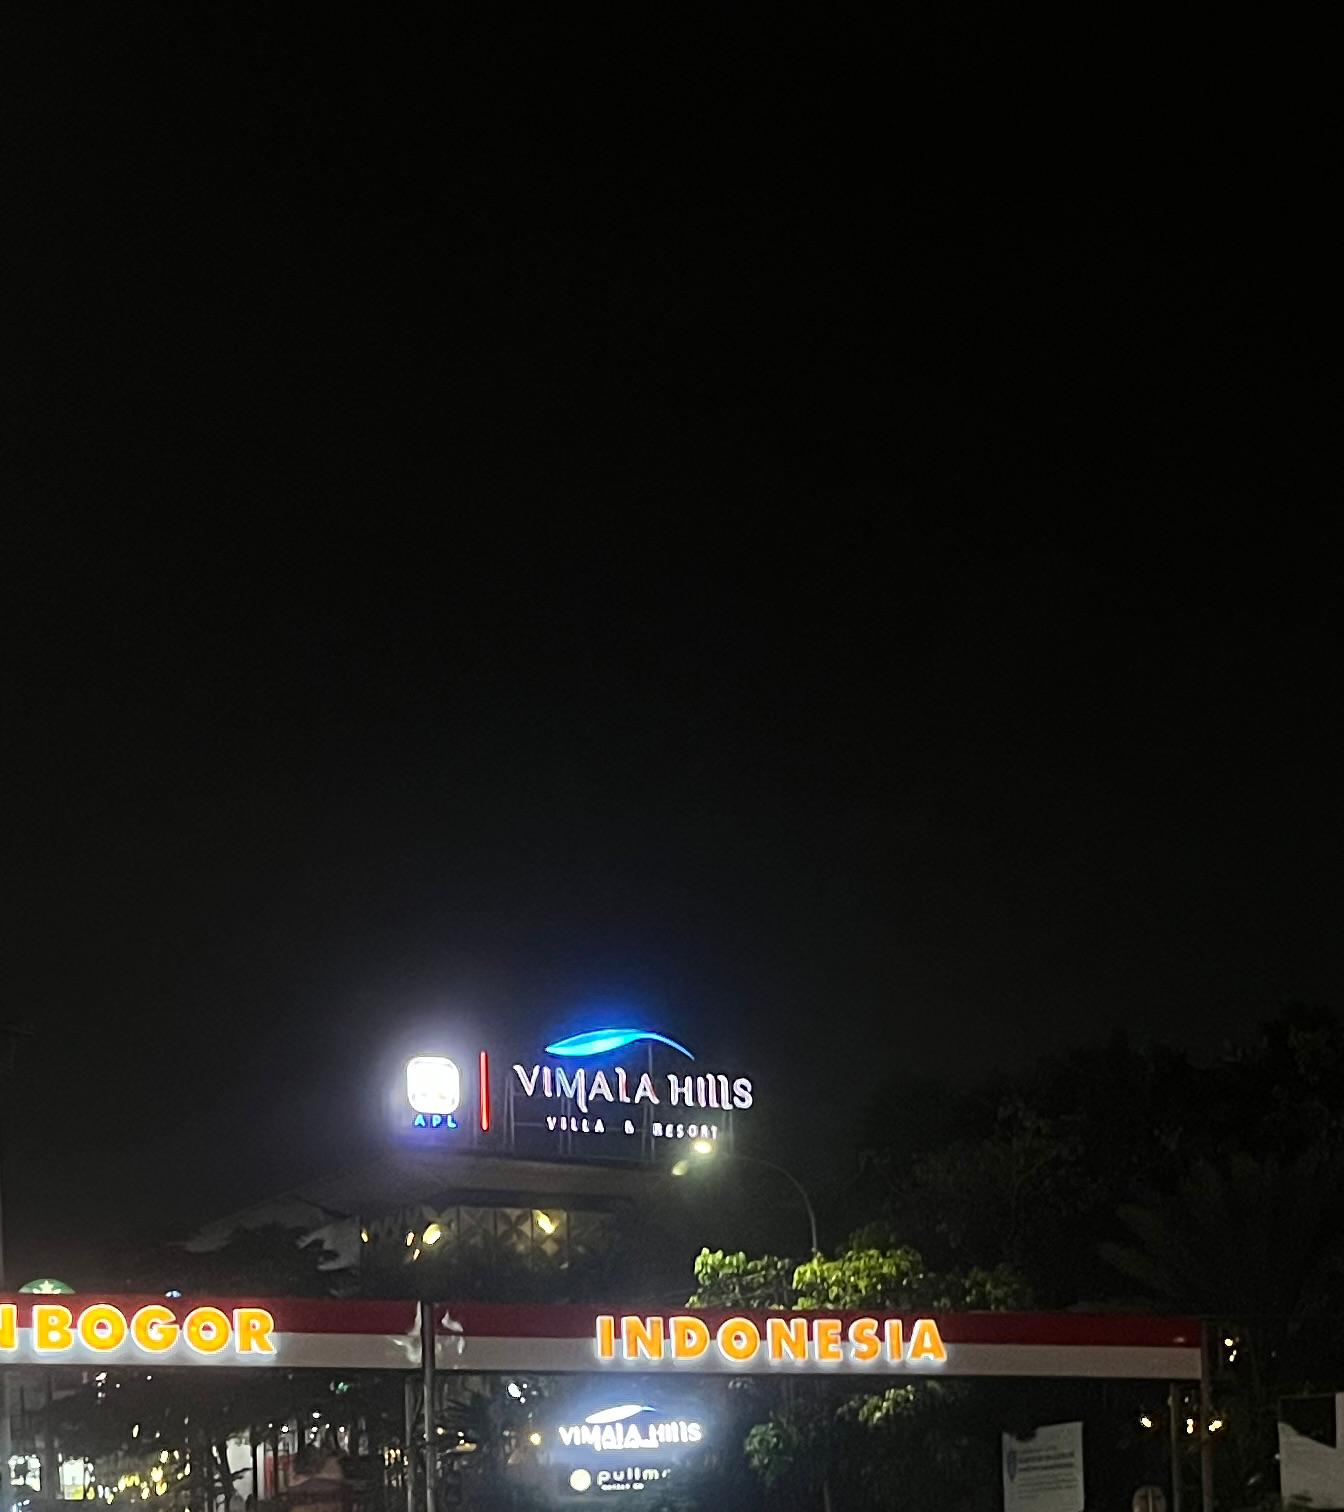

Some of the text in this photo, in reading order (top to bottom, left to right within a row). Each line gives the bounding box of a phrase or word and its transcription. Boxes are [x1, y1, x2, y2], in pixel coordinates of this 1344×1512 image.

[512, 1064, 659, 1113] VIMALA
[547, 1116, 605, 1133] VILLA
[652, 1122, 718, 1140] RESORT
[32, 1303, 276, 1355] BOGOR
[595, 1314, 948, 1363] INDONESIA
[558, 1423, 642, 1451] VIMALA
